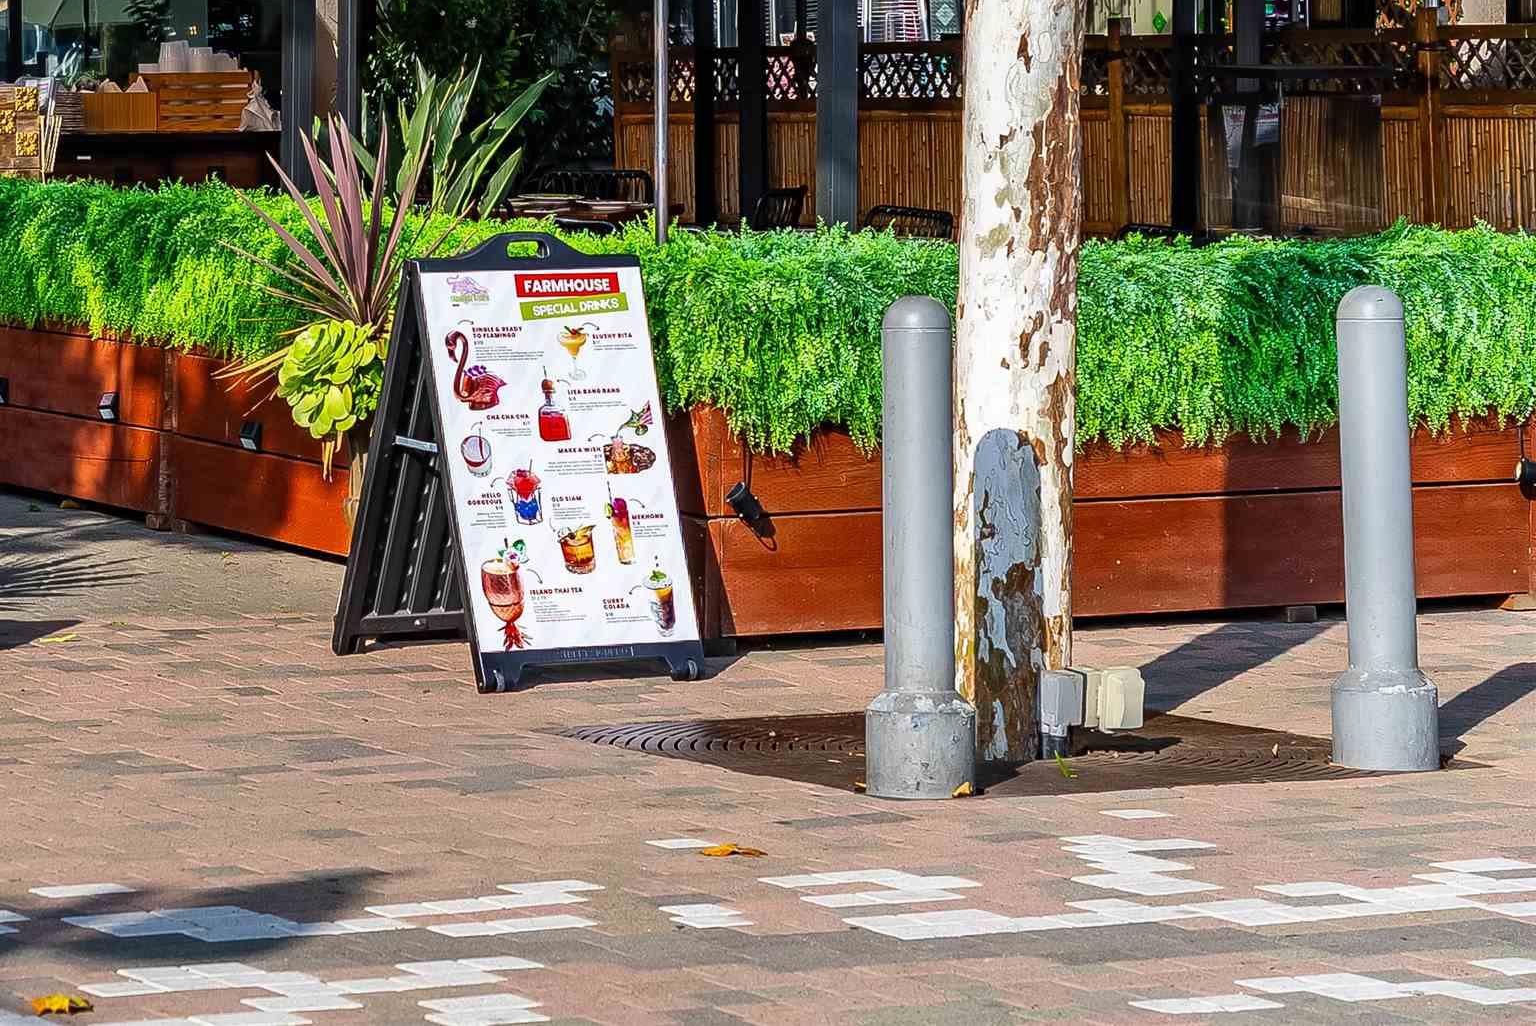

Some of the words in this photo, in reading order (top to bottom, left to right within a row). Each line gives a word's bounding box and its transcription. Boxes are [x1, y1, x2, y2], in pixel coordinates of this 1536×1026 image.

[524, 278, 611, 293] FARMHOUSE
[532, 302, 577, 317] SPECIAL
[579, 297, 620, 313] DRINKS
